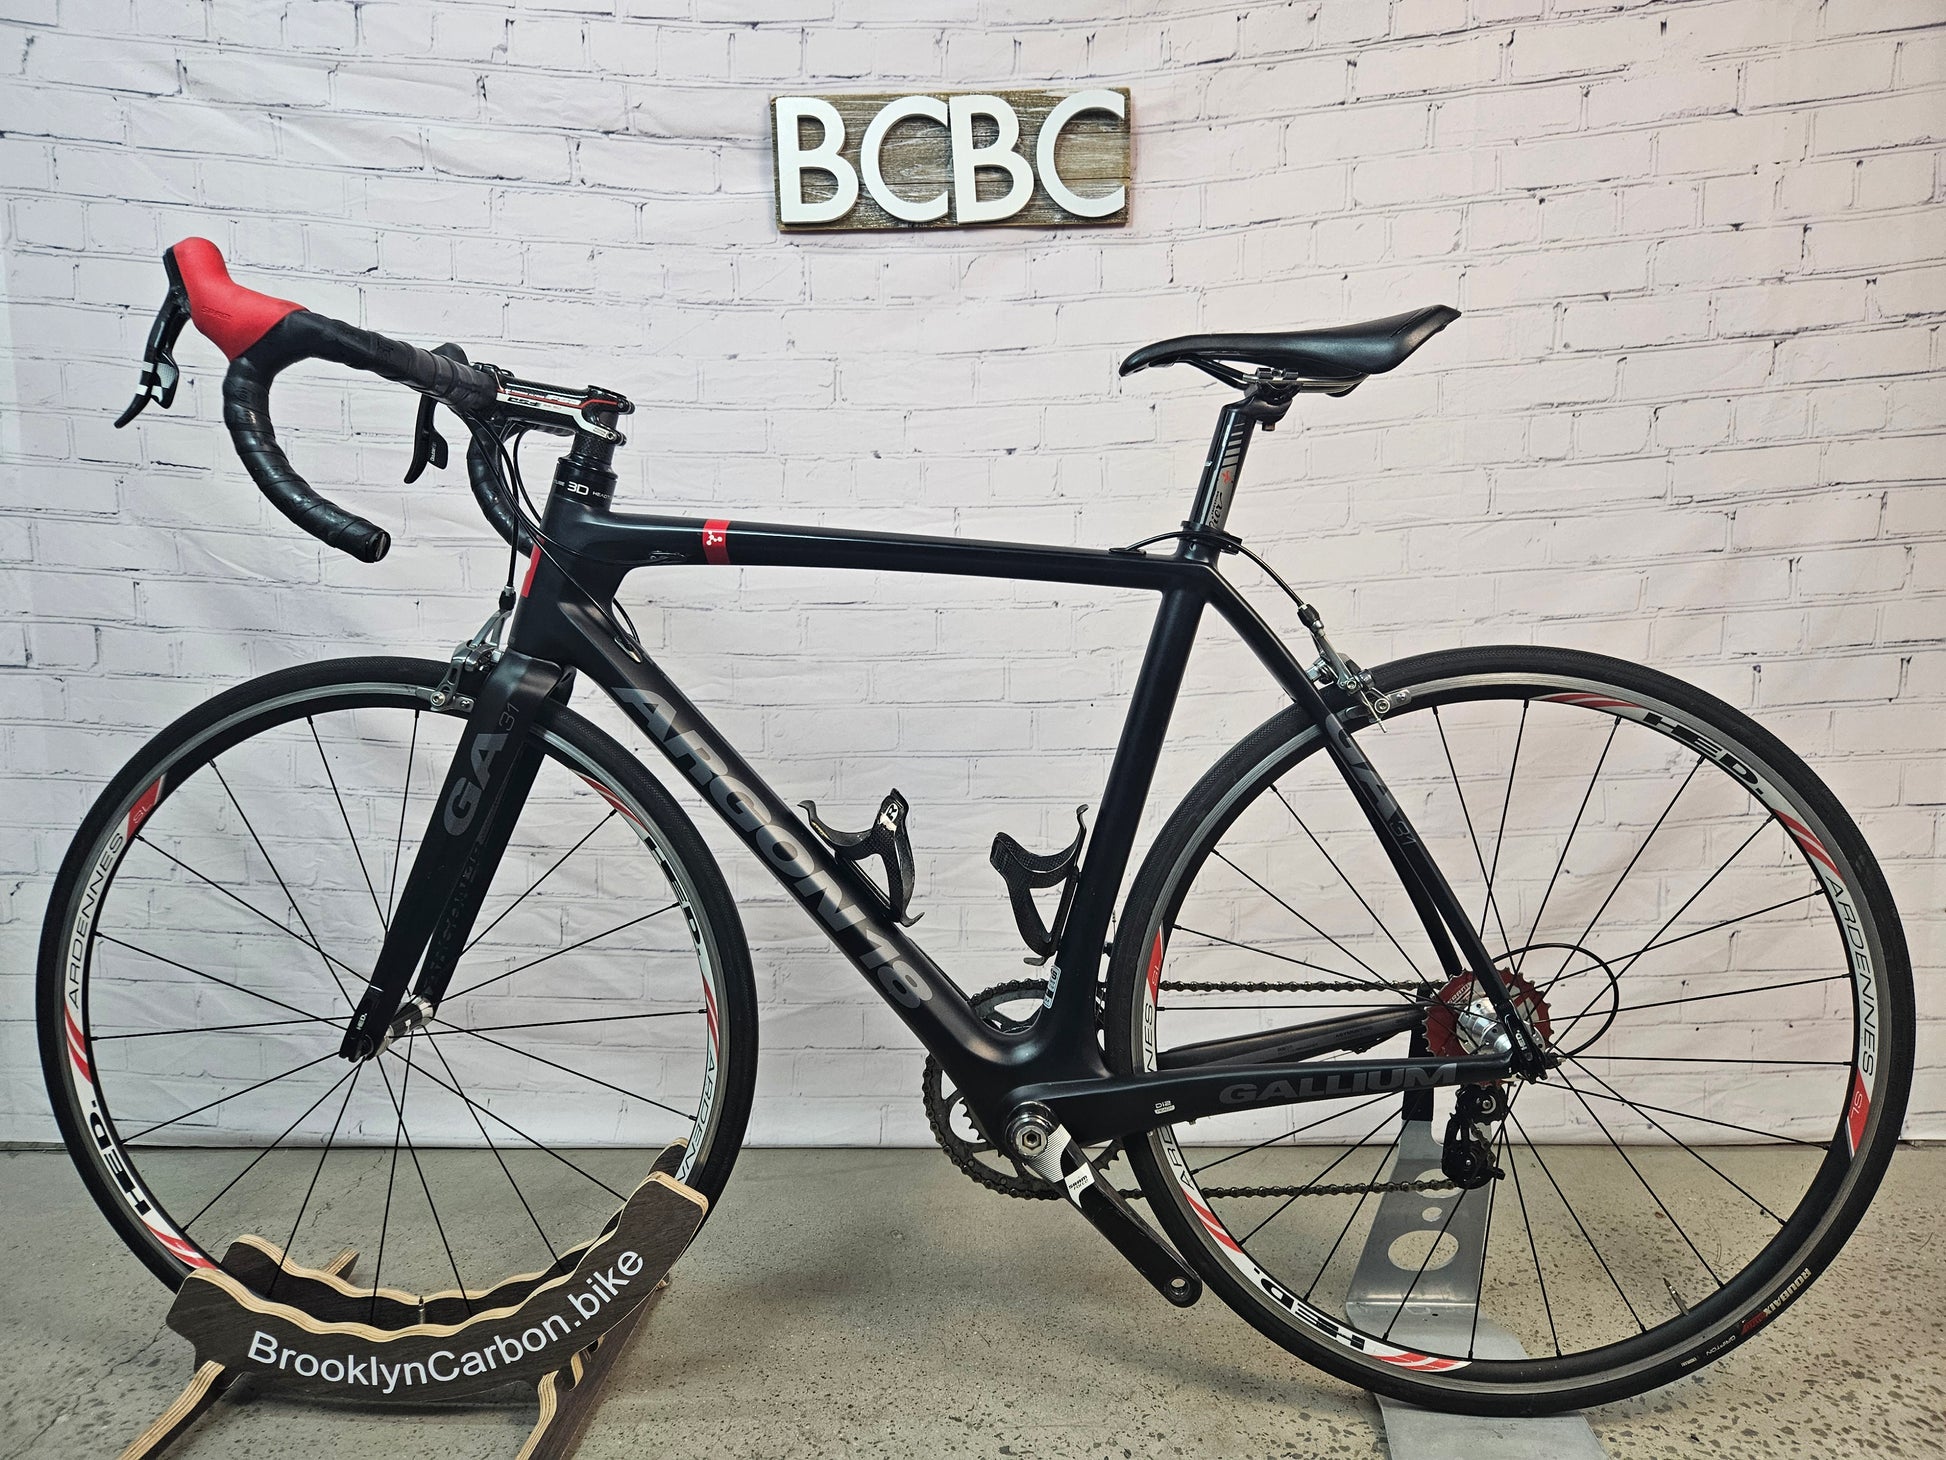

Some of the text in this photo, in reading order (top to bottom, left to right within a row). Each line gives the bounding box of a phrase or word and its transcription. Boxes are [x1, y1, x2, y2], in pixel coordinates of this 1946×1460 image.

[776, 89, 1125, 225] BCBC
[567, 481, 589, 496] 3D
[67, 801, 154, 1010] ARDENNES SL
[611, 687, 933, 1009] ARGON 18
[1825, 875, 1879, 1119] ARDENNES SL
[1218, 1062, 1458, 1105] GALLIUM
[247, 1248, 645, 1394] BrooklynCarbon.bike
[1764, 1267, 1812, 1317] ROUBAIX
